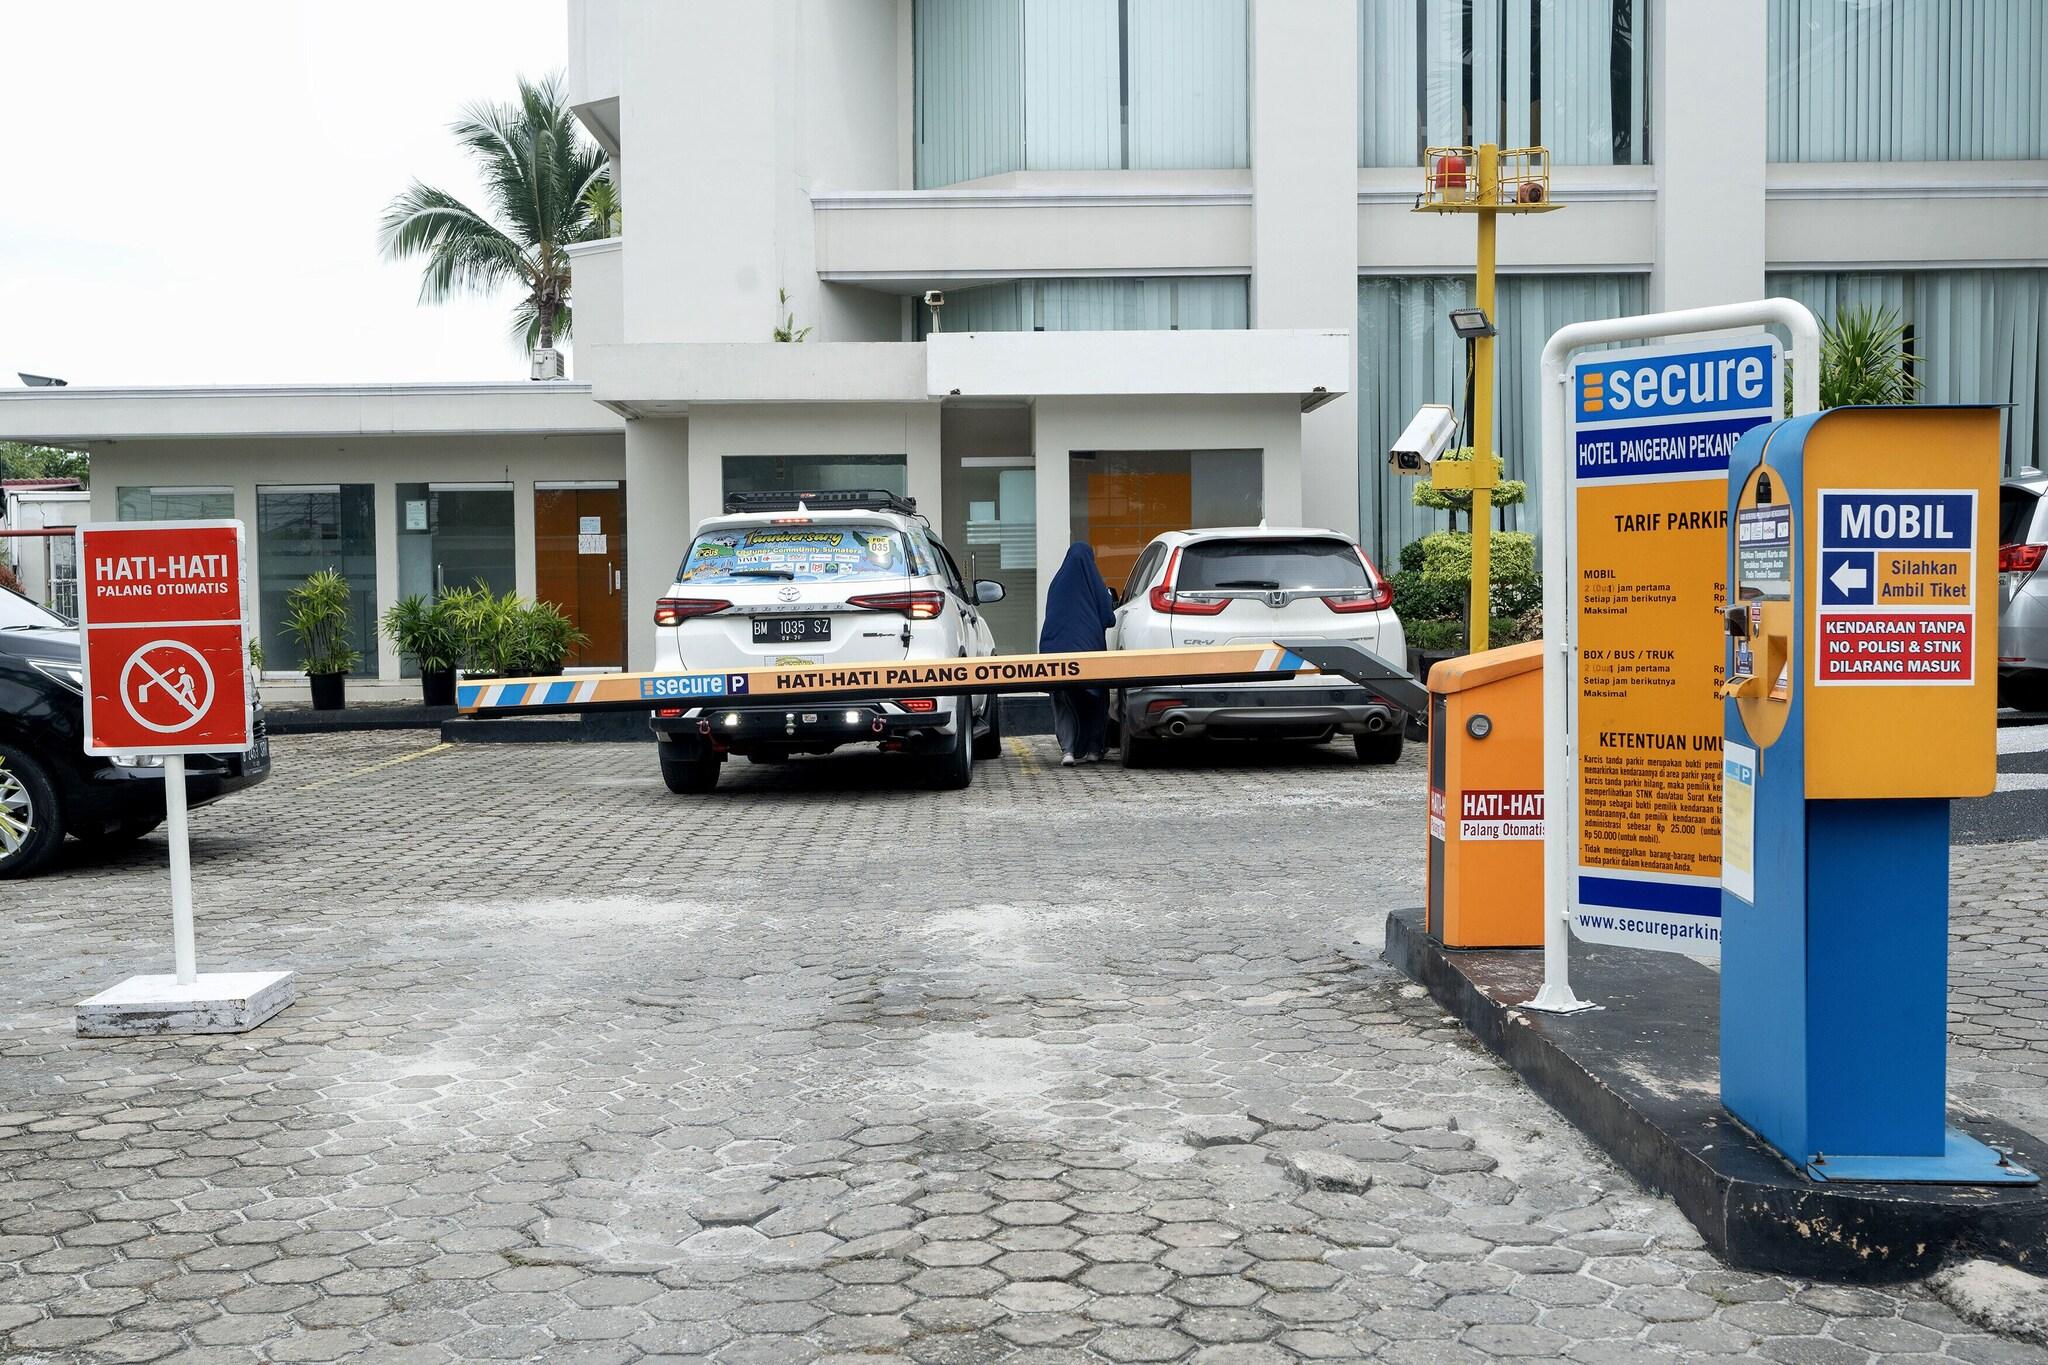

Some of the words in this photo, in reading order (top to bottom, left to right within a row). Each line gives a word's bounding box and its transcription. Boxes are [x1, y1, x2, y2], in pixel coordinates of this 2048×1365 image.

[1608, 356, 1764, 410] secure
[1579, 442, 1617, 466] HOTEL
[1620, 436, 1686, 463] PANGERAN
[1615, 513, 1661, 532] TARIF
[1668, 510, 1728, 530] PARKIR
[1840, 504, 1954, 539] MOBIL
[96, 554, 228, 580] HATI-HATI
[1891, 560, 1957, 575] Silahkan
[1584, 570, 1616, 579] MOBIL
[97, 584, 152, 596] PALANG
[157, 582, 228, 595] OTOMATIS
[1617, 584, 1633, 593] jam
[1636, 584, 1670, 593] pertama
[1714, 583, 1727, 591] Rp.
[1882, 583, 1924, 597] Ambil
[1930, 583, 1966, 597] Tiket
[1584, 595, 1610, 604] Setiap
[1613, 595, 1628, 604] jam
[1631, 594, 1676, 604] berikutnya
[1714, 594, 1727, 602] Rp.
[754, 622, 768, 635] BM
[780, 620, 805, 634] 1035
[814, 620, 829, 633] SZ
[1826, 621, 1915, 634] KENDARAAN
[1920, 621, 1966, 634] TANPA
[1829, 641, 1854, 653] NO.
[1858, 641, 1904, 653] POLISI
[1909, 641, 1920, 653] &
[1924, 641, 1962, 653] STNK
[1584, 650, 1604, 659] BOX
[1606, 650, 1611, 659] /
[1614, 650, 1635, 659] BUS
[1638, 650, 1643, 659] /
[1646, 650, 1674, 659] TRUK
[1617, 665, 1632, 674] jam
[1636, 665, 1670, 674] pertama
[1830, 660, 1904, 673] DILARANG
[1908, 660, 1960, 672] MASUK
[777, 671, 878, 688] HATI-HATI
[886, 667, 968, 684] PALANG
[975, 662, 1080, 680] OTOMATIS
[1584, 677, 1610, 686] Setiap
[1613, 677, 1628, 686] jam
[1631, 677, 1676, 686] berikutnya
[656, 674, 722, 695] secure
[732, 676, 744, 692] P
[1600, 732, 1686, 750] KETENTUAN
[1584, 755, 1603, 763] Karcis
[1606, 756, 1622, 764] tanda
[1626, 757, 1644, 766] parkir
[1648, 759, 1682, 768] merupakan
[1584, 766, 1618, 774] memarkirkan
[1620, 767, 1658, 778] kendaraannya
[1681, 771, 1699, 779] parkir
[1701, 773, 1716, 781] yang
[1742, 768, 1750, 781] P
[1585, 776, 1603, 784] karcis
[1605, 777, 1621, 786] tanda
[1624, 778, 1642, 787] parkir
[1668, 781, 1684, 789] maka
[1687, 782, 1710, 791] pemilik
[1585, 788, 1632, 797] memperlihatkan
[1636, 790, 1652, 798] STNK
[1656, 791, 1683, 800] dan/atau
[1688, 793, 1704, 801] Surat
[1585, 797, 1606, 808] lainnya
[1609, 799, 1632, 809] sebagai
[1636, 800, 1651, 809] bukti
[1654, 802, 1677, 811] pemilik
[1681, 803, 1714, 813] kendaraan
[1645, 813, 1668, 822] pemilik
[1673, 814, 1706, 824] kendaraan
[1464, 823, 1499, 838] Palang
[1585, 820, 1621, 829] administrasi
[1627, 822, 1651, 831] sebesar
[1657, 824, 1665, 834] Rp
[1671, 824, 1695, 834] 25.000
[1585, 830, 1592, 839] Rp
[1594, 830, 1617, 840] 50.000
[1618, 832, 1637, 842] (untuk
[1584, 844, 1600, 853] Tidak
[1604, 847, 1646, 857] meninggalkan
[1650, 849, 1695, 862] barang-barang
[1585, 856, 1601, 864] tanda
[1603, 857, 1620, 866] parkir
[1621, 858, 1639, 867] dalam
[1641, 860, 1673, 869] kendaraan
